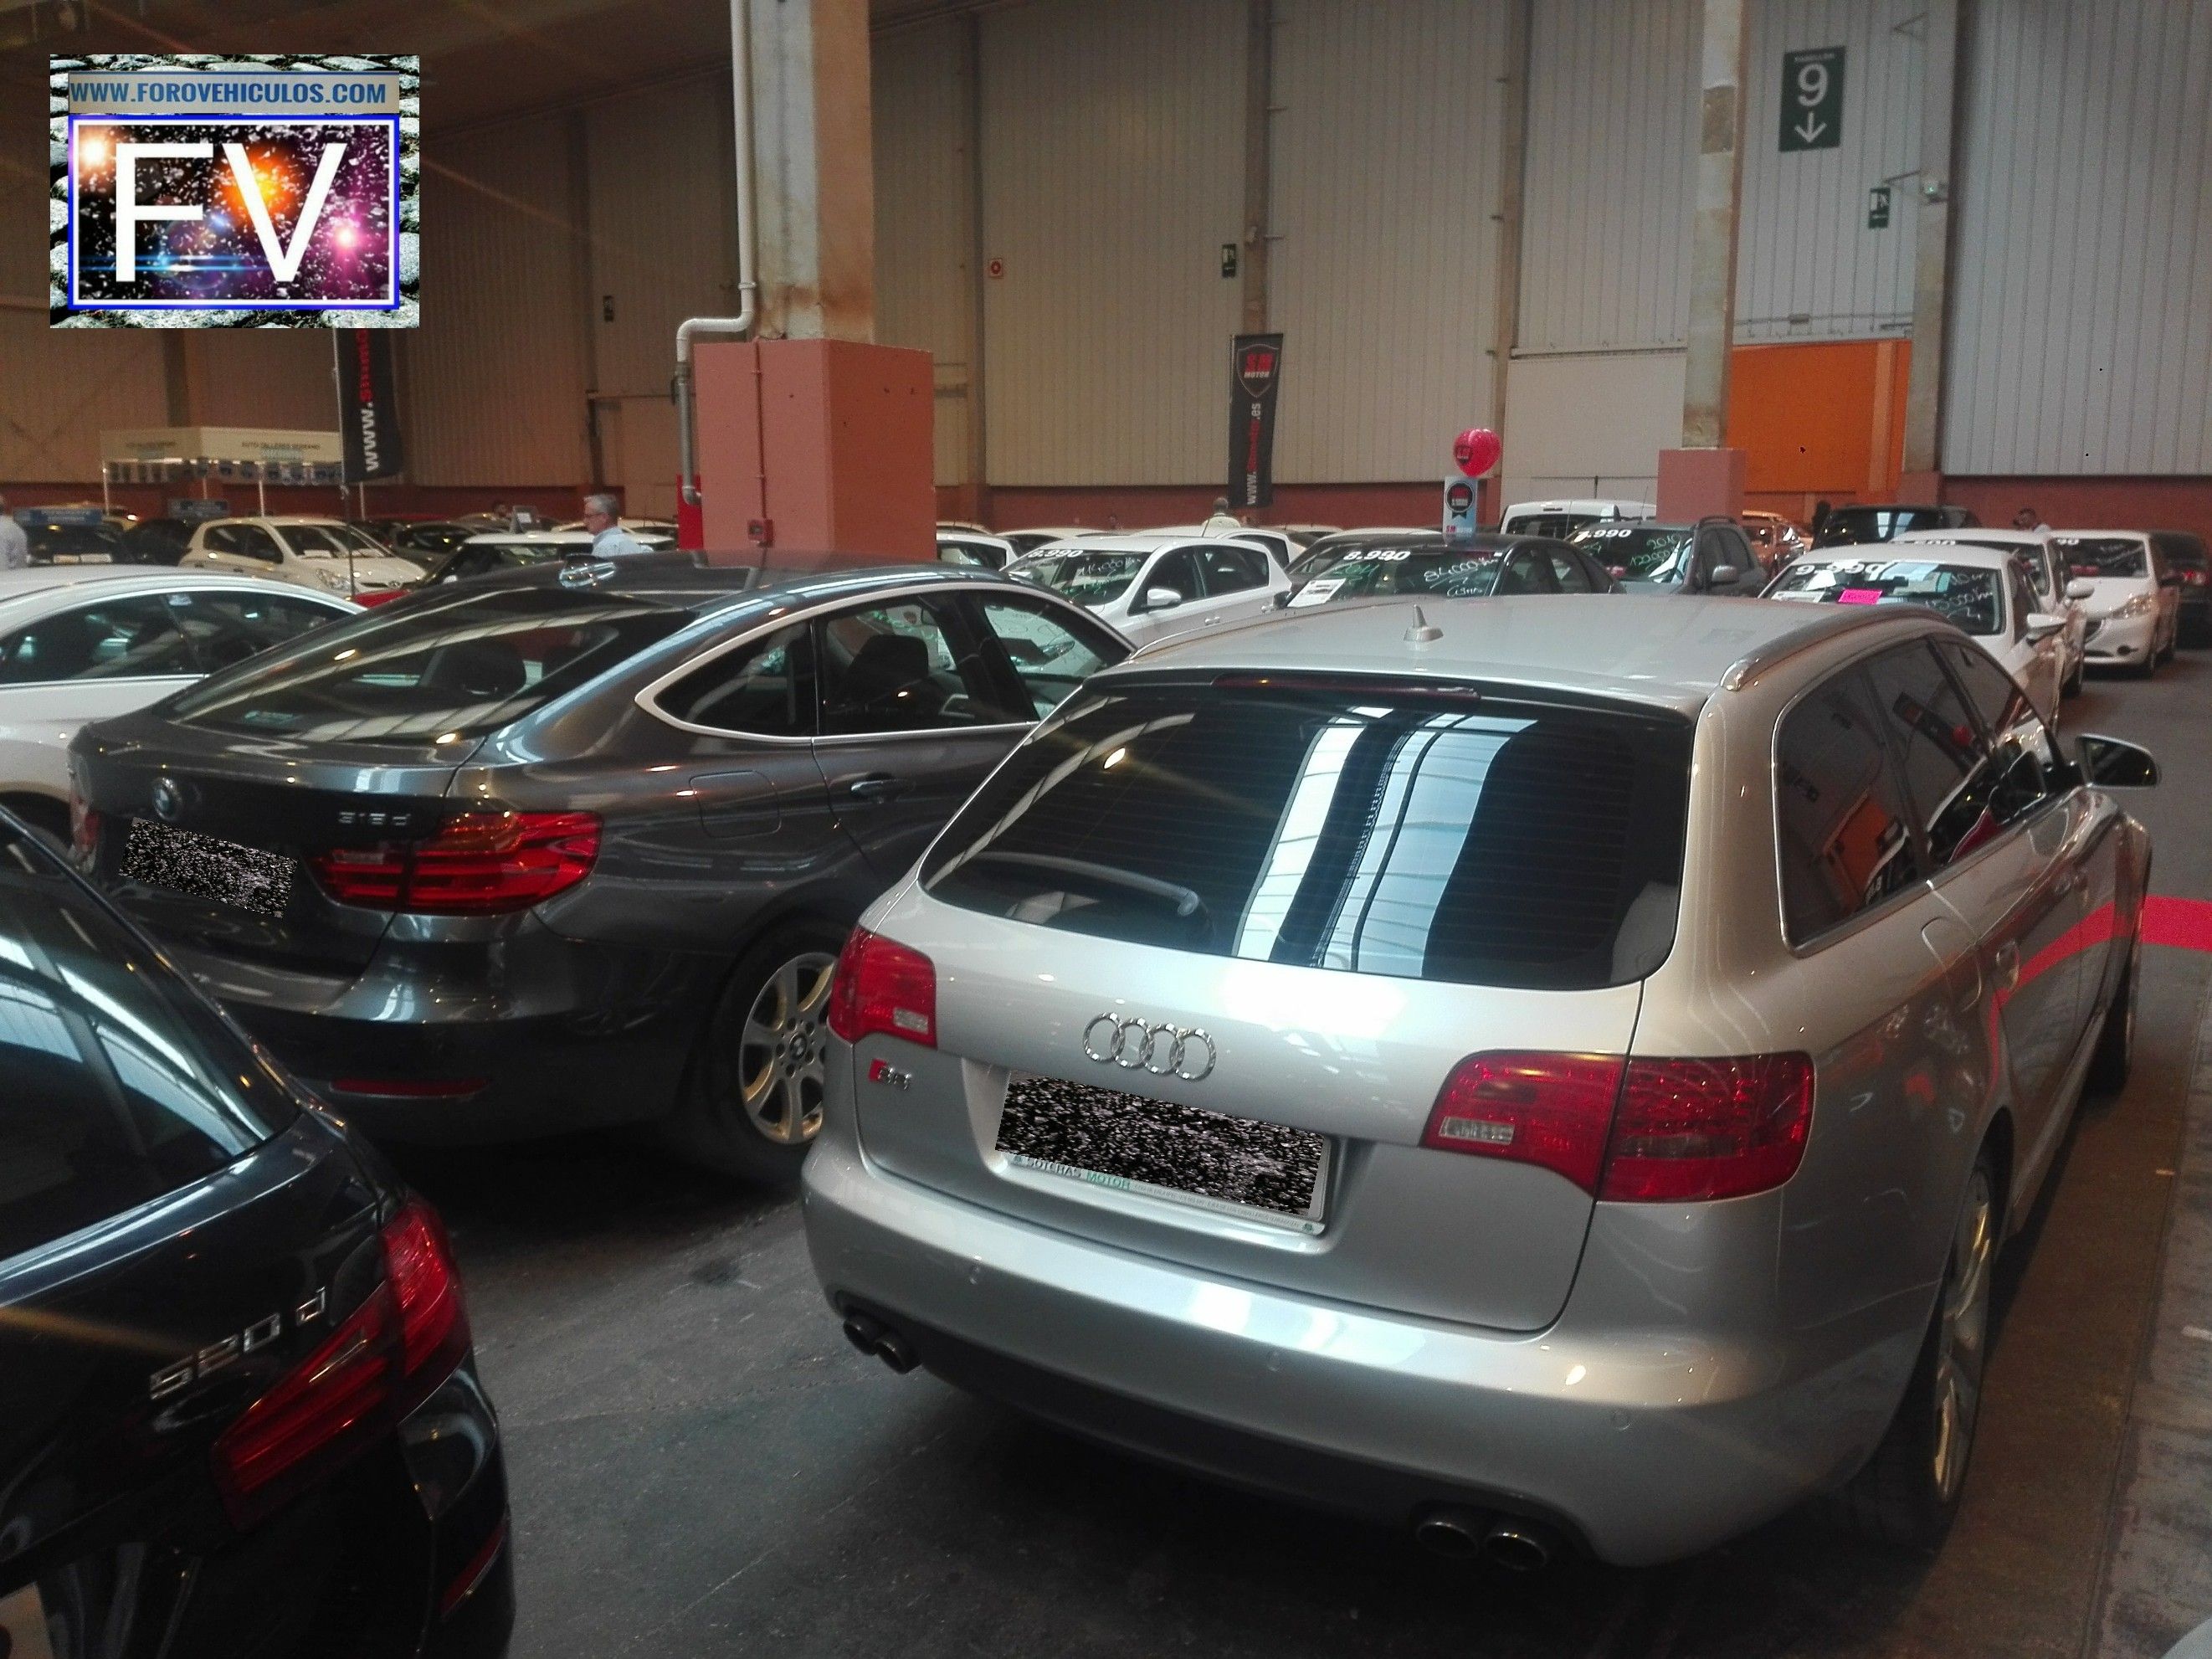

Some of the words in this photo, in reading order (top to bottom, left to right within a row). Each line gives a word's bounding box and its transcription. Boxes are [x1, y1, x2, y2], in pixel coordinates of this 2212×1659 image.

[1798, 64, 1828, 106] 9
[1343, 551, 1410, 561] 8.990
[1086, 1170, 1130, 1190] MOTOR
